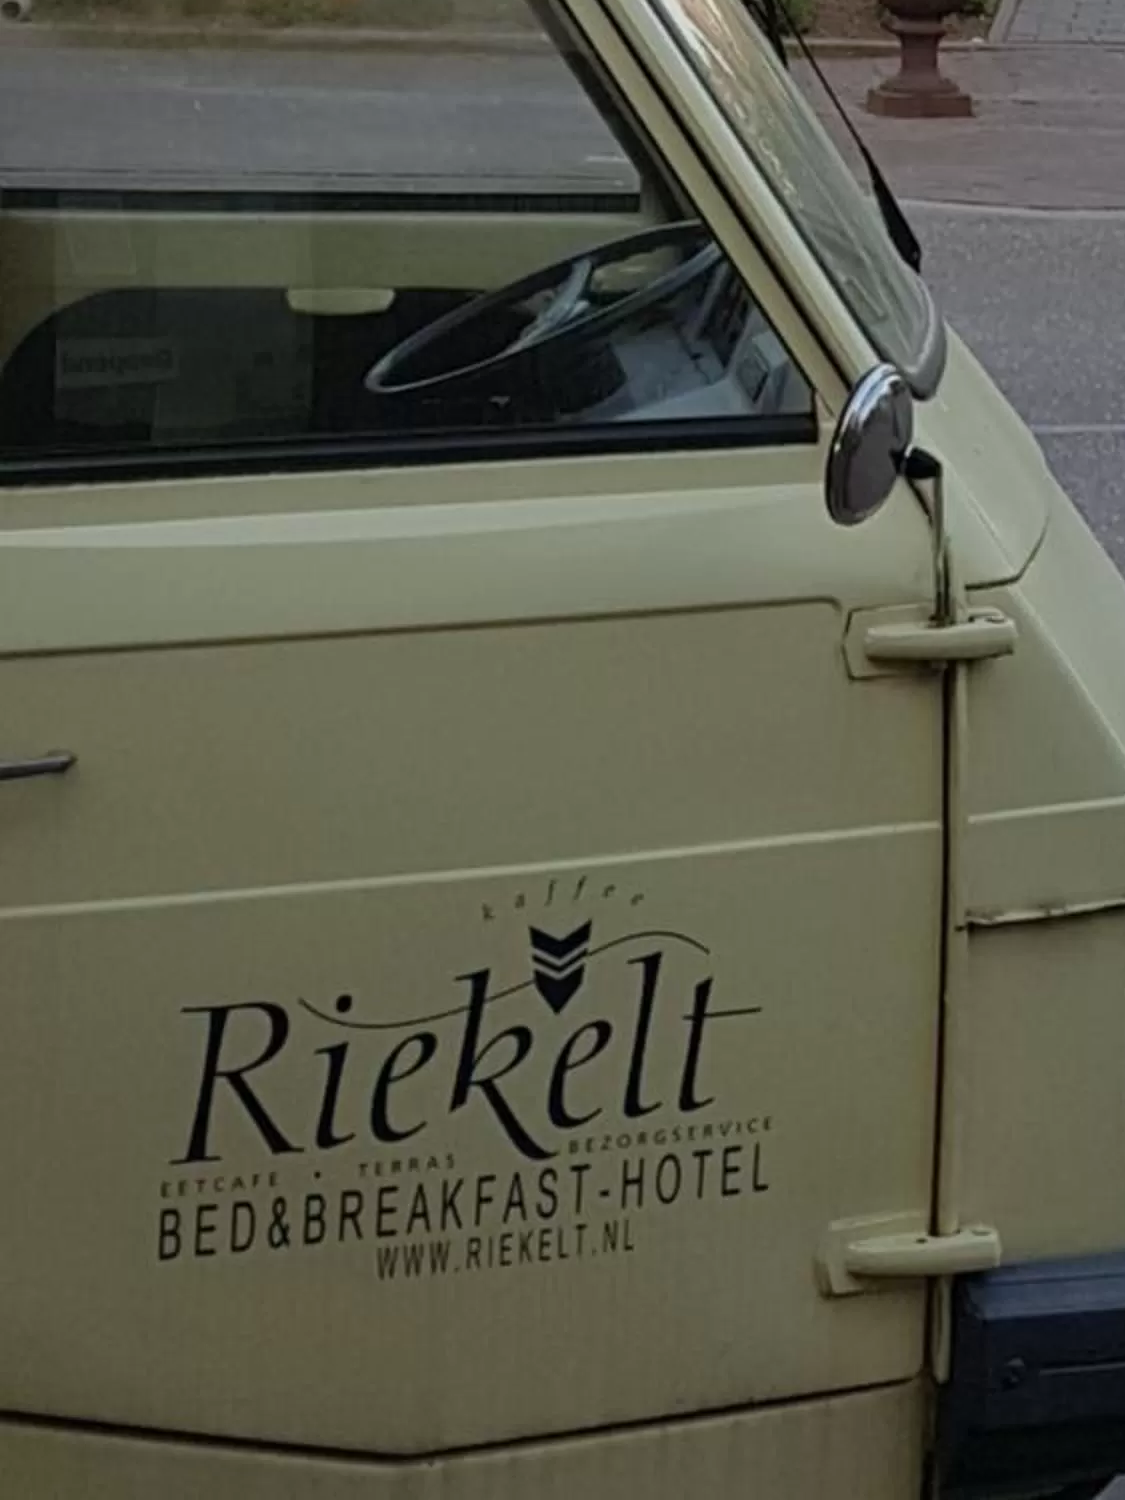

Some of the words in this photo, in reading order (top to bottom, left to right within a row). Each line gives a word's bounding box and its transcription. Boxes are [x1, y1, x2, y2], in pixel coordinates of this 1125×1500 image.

[169, 950, 763, 1161] Riekelt
[357, 1152, 456, 1178] TERRAS
[568, 1115, 774, 1155] BEZORGSERVICE
[157, 1141, 770, 1262] BED&BREAKFAST-HOTEL
[375, 1218, 636, 1280] WWW.RIEKELT.NL
